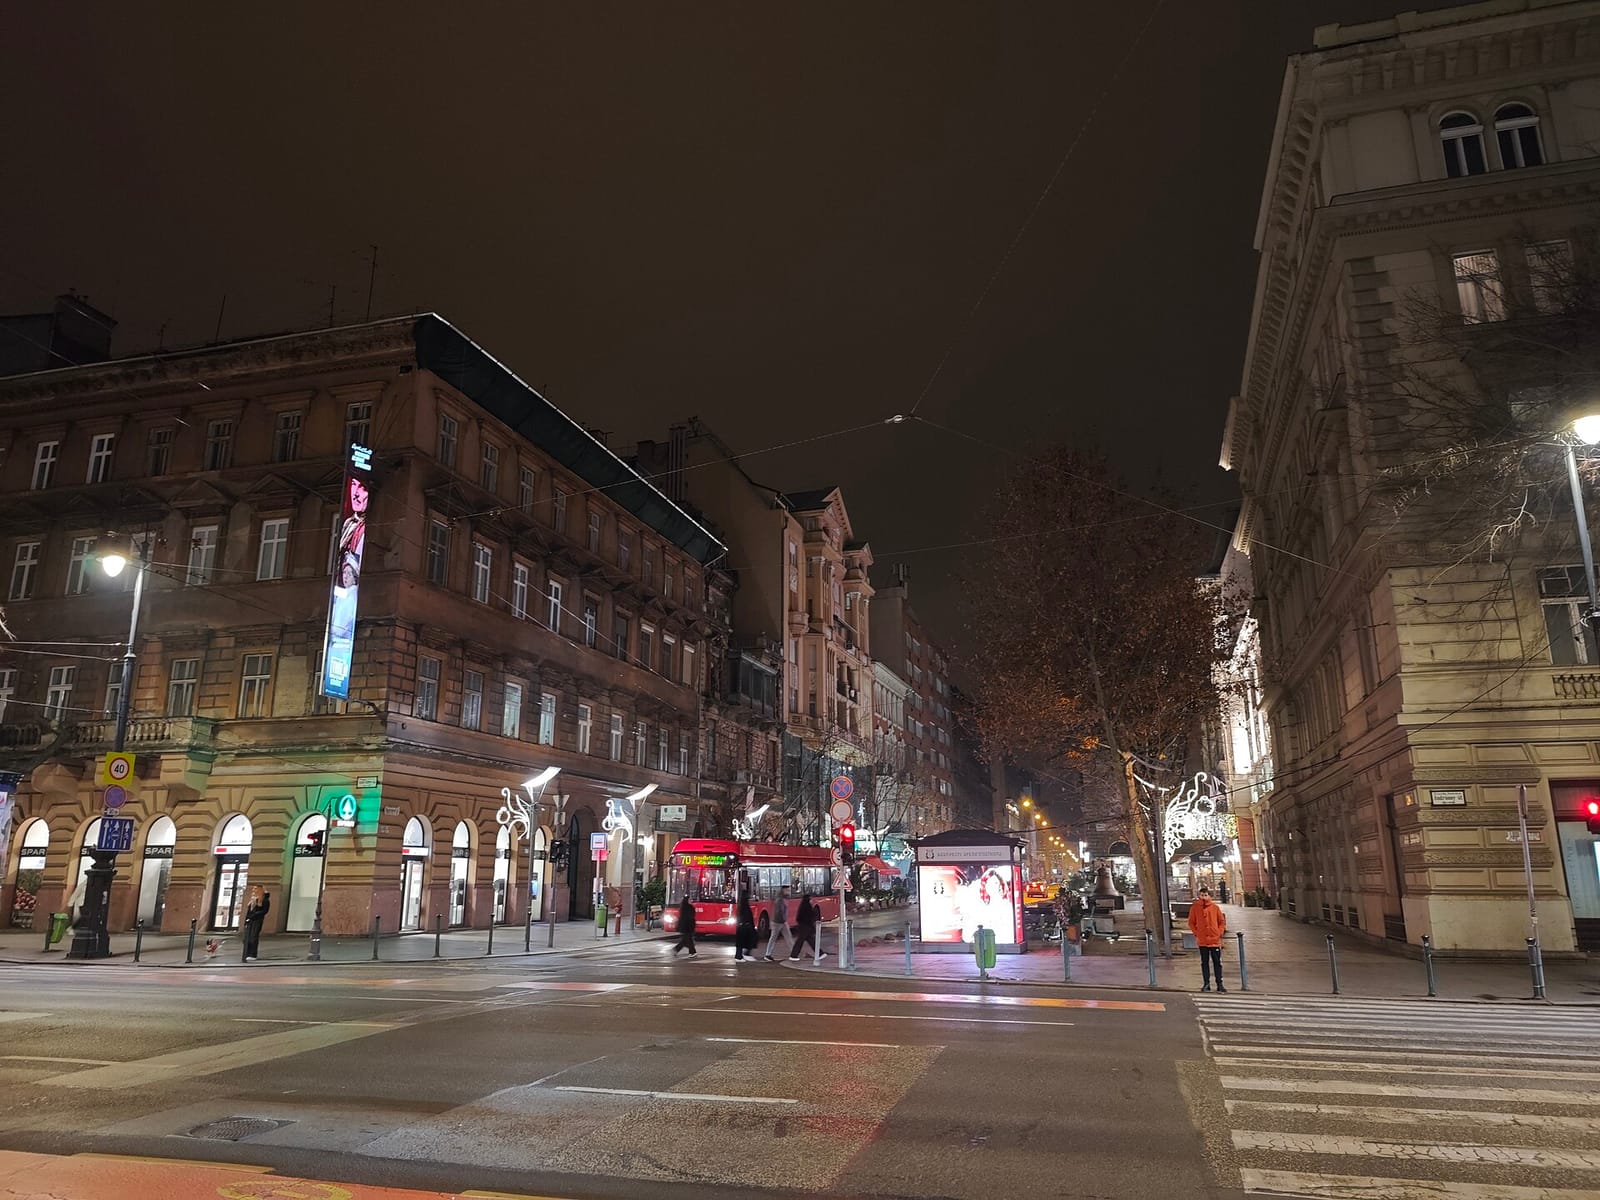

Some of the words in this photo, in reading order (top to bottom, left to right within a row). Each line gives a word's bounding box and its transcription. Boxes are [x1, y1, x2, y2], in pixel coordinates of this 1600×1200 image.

[114, 764, 125, 774] 40
[21, 848, 46, 856] SPAR
[144, 847, 172, 855] SPAR
[681, 855, 691, 865] 70
